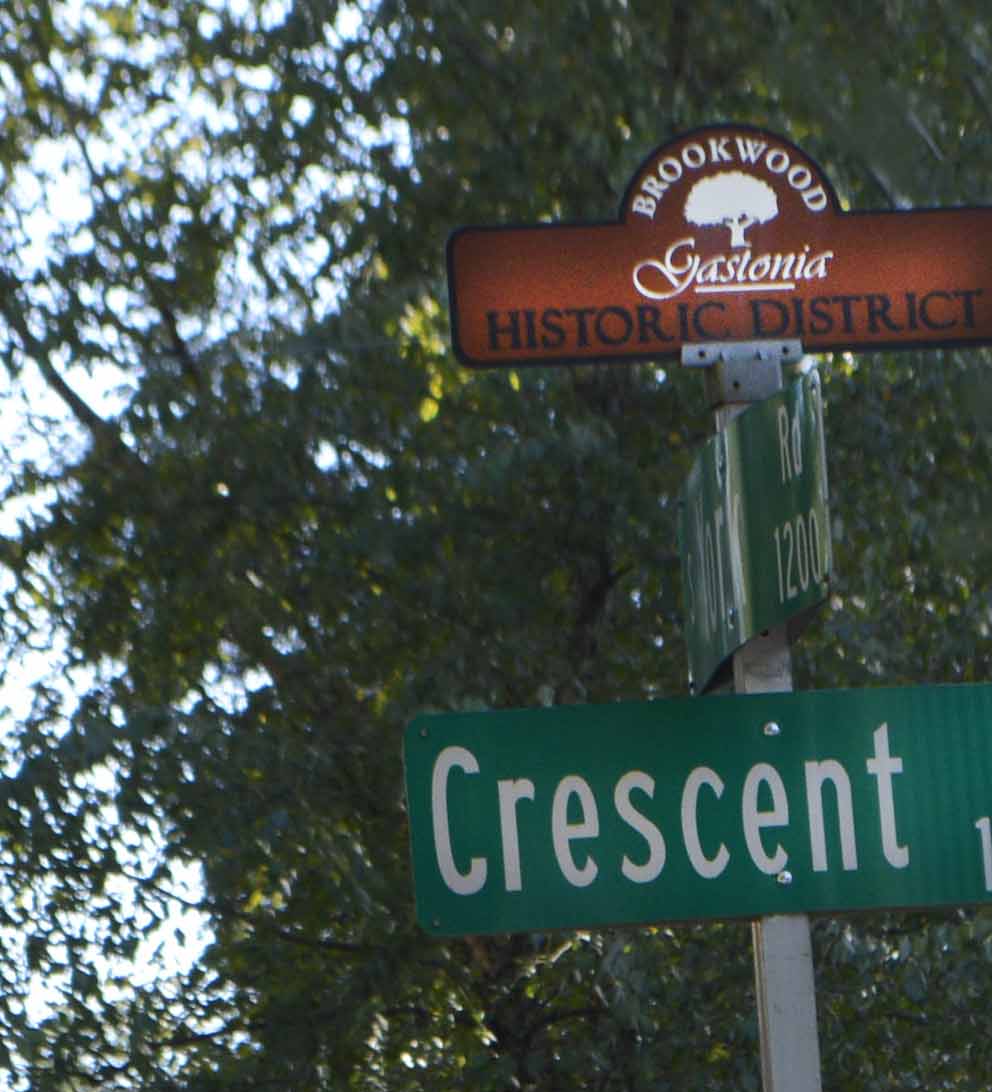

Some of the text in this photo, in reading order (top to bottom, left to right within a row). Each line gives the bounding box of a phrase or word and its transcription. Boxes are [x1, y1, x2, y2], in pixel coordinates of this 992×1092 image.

[631, 136, 828, 221] BROOKWOOD
[632, 237, 834, 300] Gastonia
[487, 287, 983, 351] HISTORIC DISTRICT
[773, 507, 821, 604] 1200
[431, 722, 910, 896] Crescent
